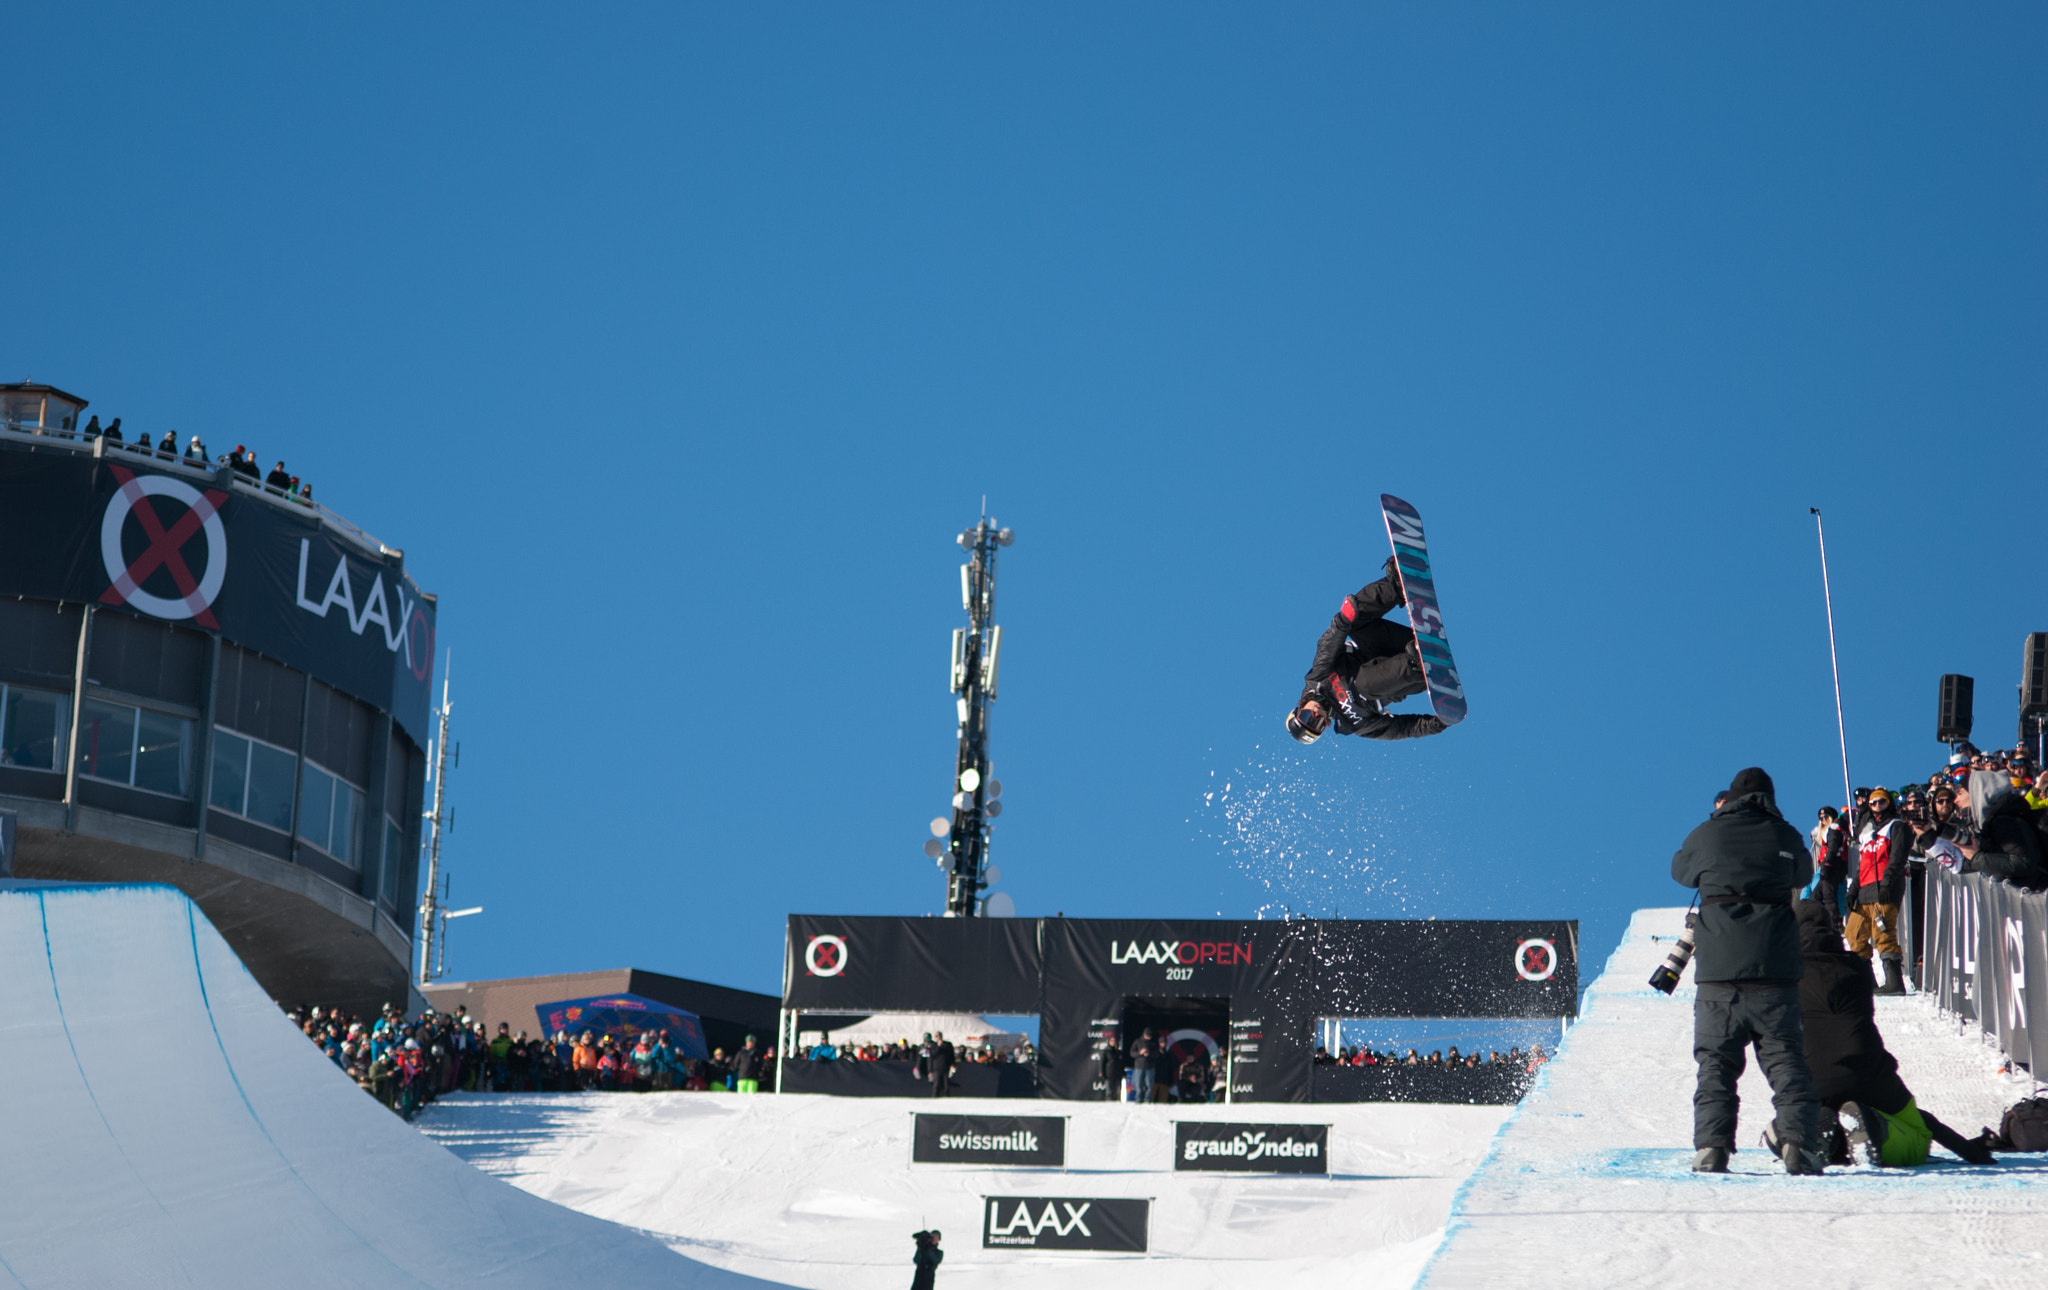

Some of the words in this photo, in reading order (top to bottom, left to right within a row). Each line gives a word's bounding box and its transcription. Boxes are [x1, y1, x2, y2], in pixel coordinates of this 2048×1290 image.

[1166, 968, 1193, 980] 2017
[1232, 1084, 1253, 1093] LAAX
[939, 1130, 1038, 1151] swissmilk
[990, 1200, 1091, 1236] LAAX
[989, 1236, 1036, 1244] Switzerland
